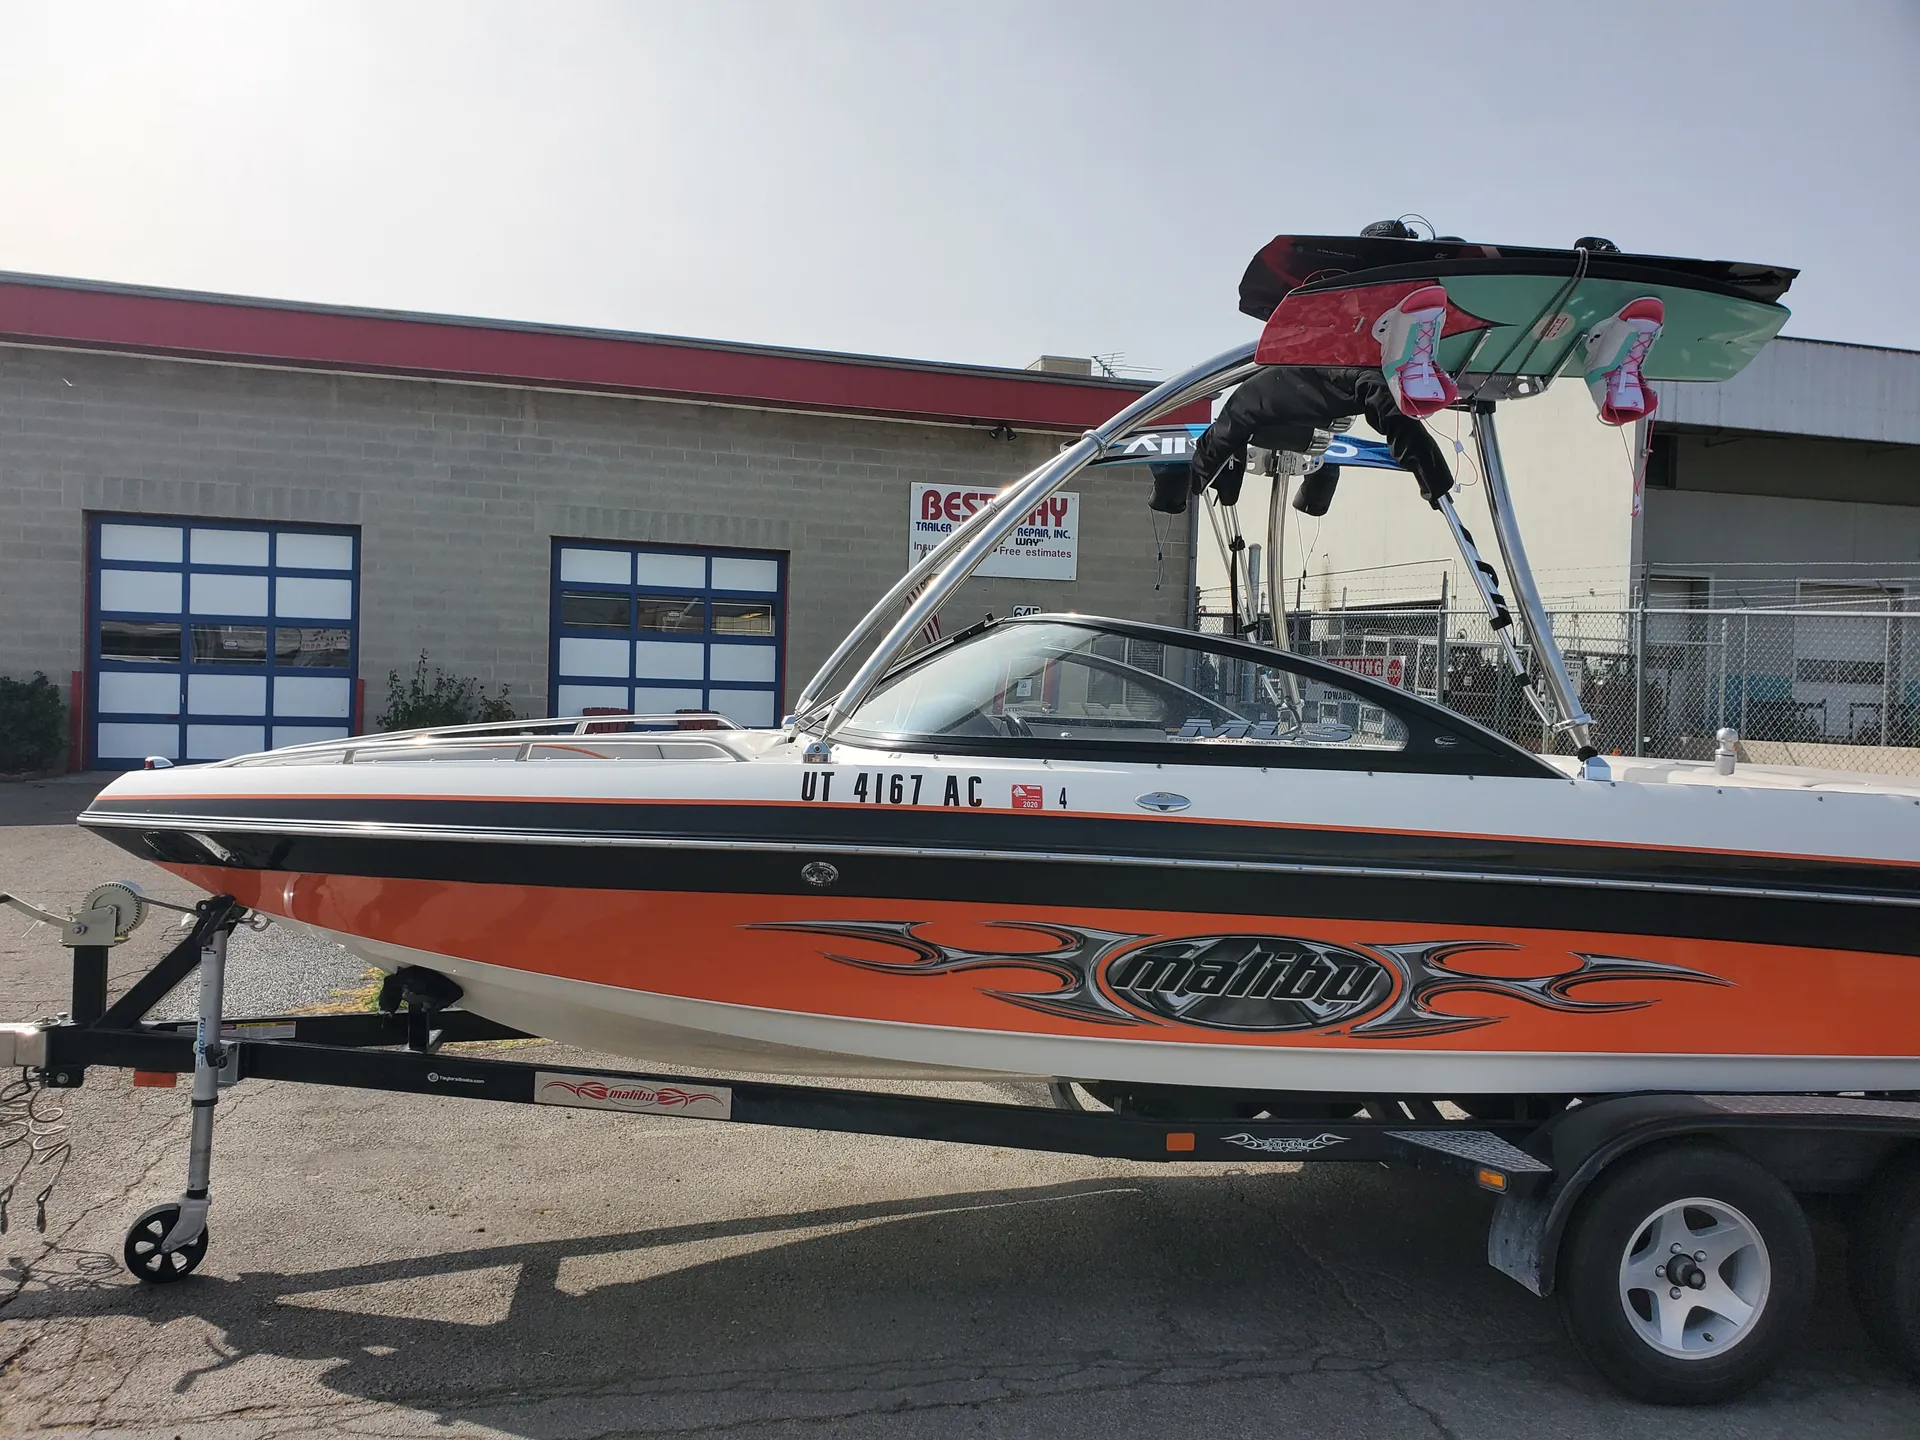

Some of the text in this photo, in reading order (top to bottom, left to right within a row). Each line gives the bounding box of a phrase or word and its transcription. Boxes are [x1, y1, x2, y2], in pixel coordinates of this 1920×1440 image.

[916, 521, 952, 533] TRAILER
[1053, 529, 1071, 540] INC.
[1000, 546, 1072, 559] Free estimates
[801, 771, 983, 807] UT 4167 AC
[1022, 800, 1039, 808] 2020
[1059, 787, 1067, 809] 4
[1111, 951, 1384, 1003] malibu
[609, 1089, 656, 1102] malibu
